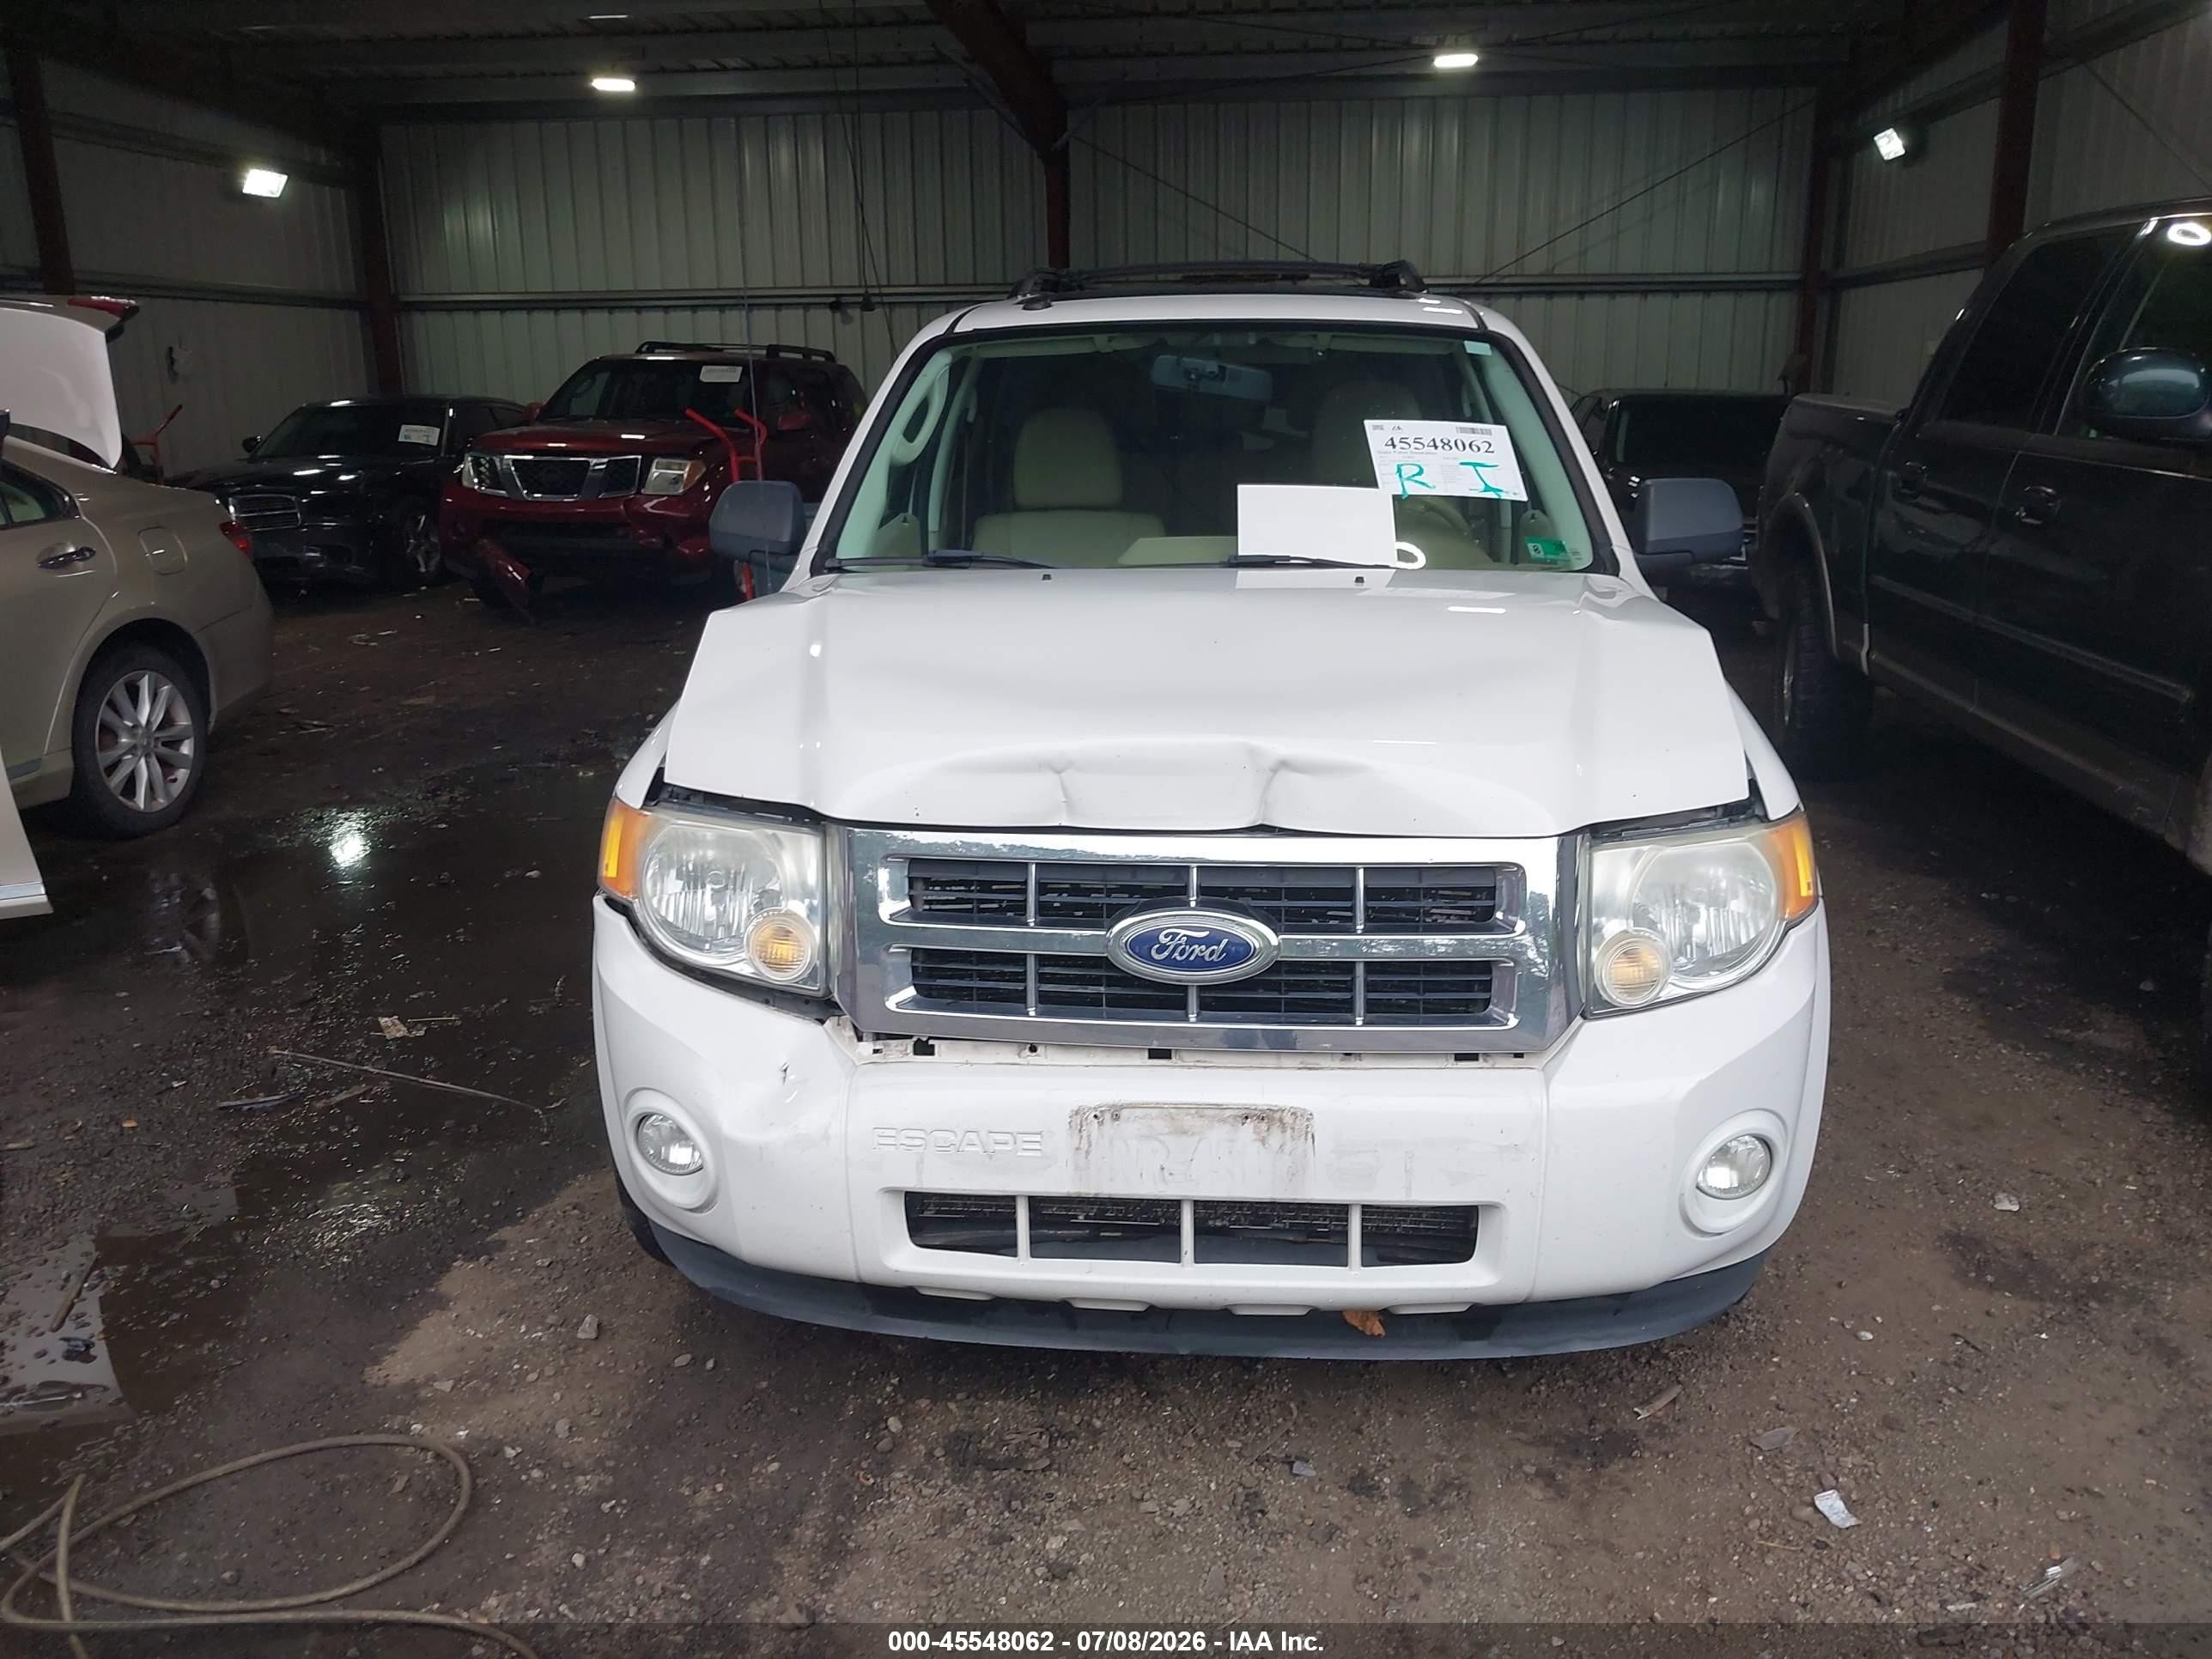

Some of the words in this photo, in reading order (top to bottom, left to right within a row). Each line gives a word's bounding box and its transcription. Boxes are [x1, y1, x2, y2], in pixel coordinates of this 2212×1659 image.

[1384, 436, 1495, 454] 45548062
[1395, 462, 1436, 500] R
[1151, 928, 1230, 962] Ford
[872, 1126, 1044, 1157] ESCAPE
